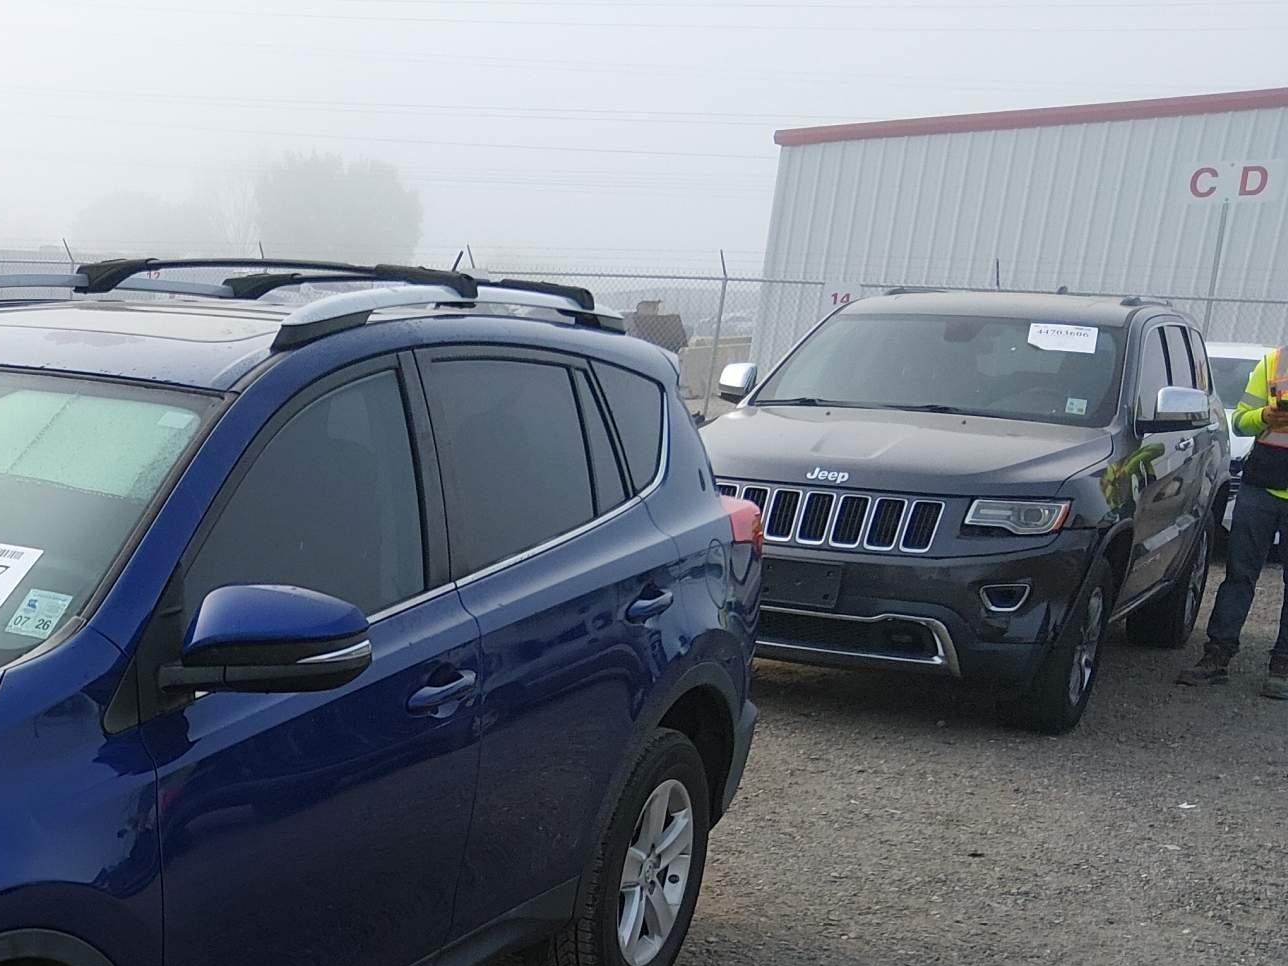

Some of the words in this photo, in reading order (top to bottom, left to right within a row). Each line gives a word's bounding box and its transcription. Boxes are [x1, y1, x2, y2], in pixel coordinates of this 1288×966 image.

[1190, 167, 1219, 198] C
[1238, 165, 1269, 196] D
[806, 467, 849, 484] Jeep
[13, 615, 31, 626] 07
[35, 618, 52, 631] 26
